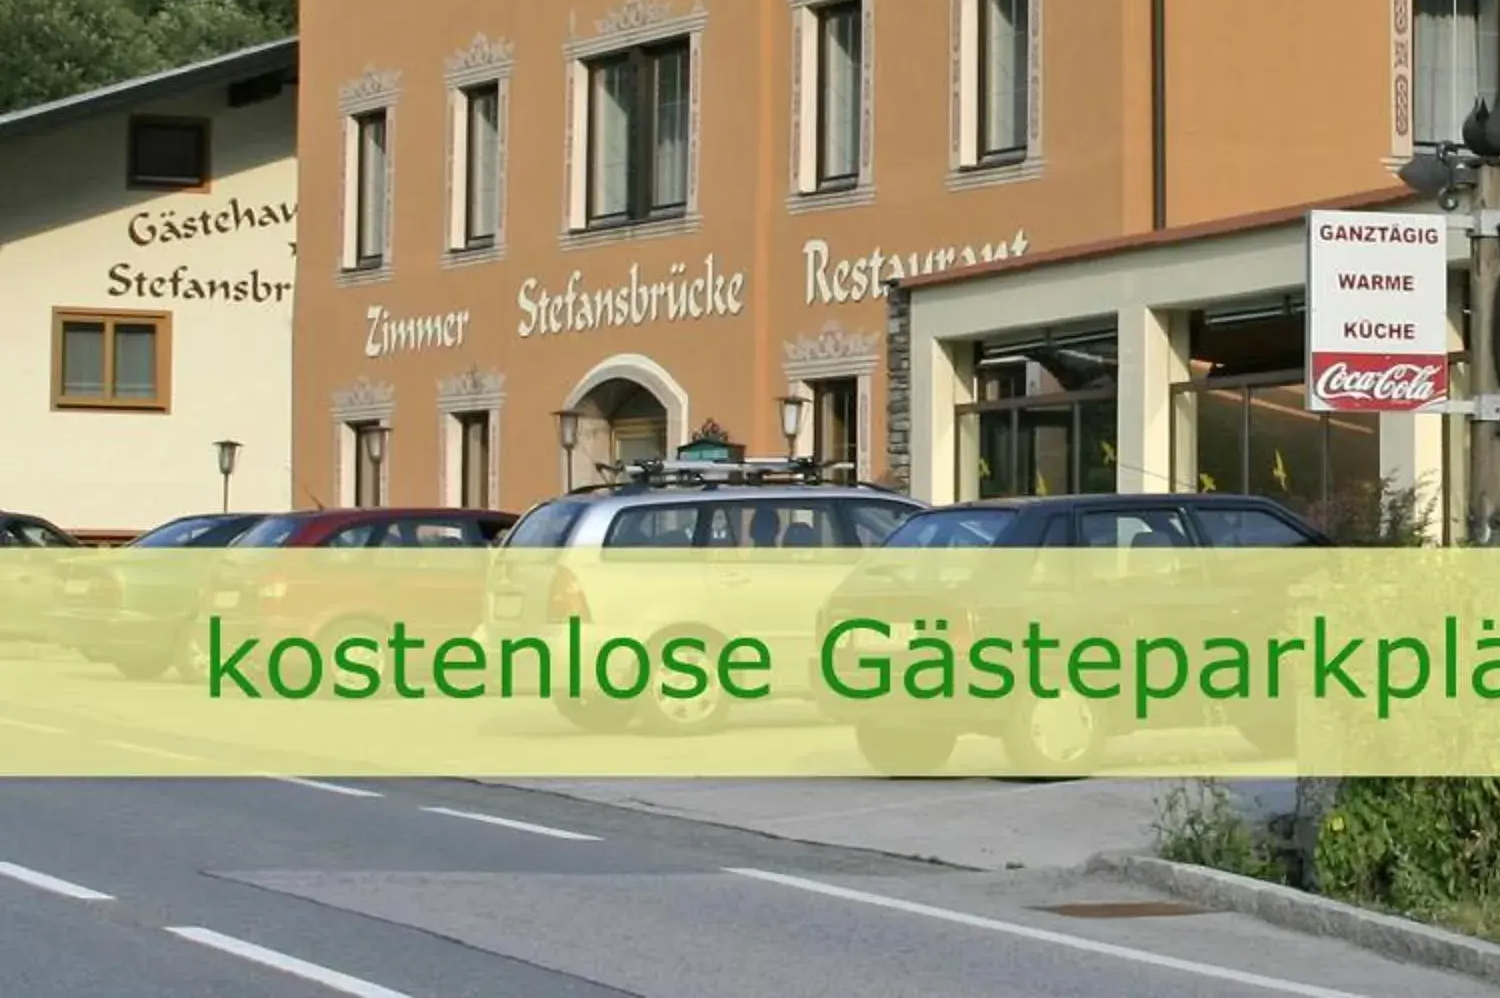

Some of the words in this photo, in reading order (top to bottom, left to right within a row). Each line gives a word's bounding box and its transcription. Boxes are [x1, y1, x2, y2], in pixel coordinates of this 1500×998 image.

[1319, 223, 1440, 245] GANZTÄGIG
[1338, 273, 1415, 292] WARME
[517, 253, 745, 338] Stefansbrücke
[365, 305, 470, 358] Zimmer
[1343, 319, 1416, 340] KÜCHE
